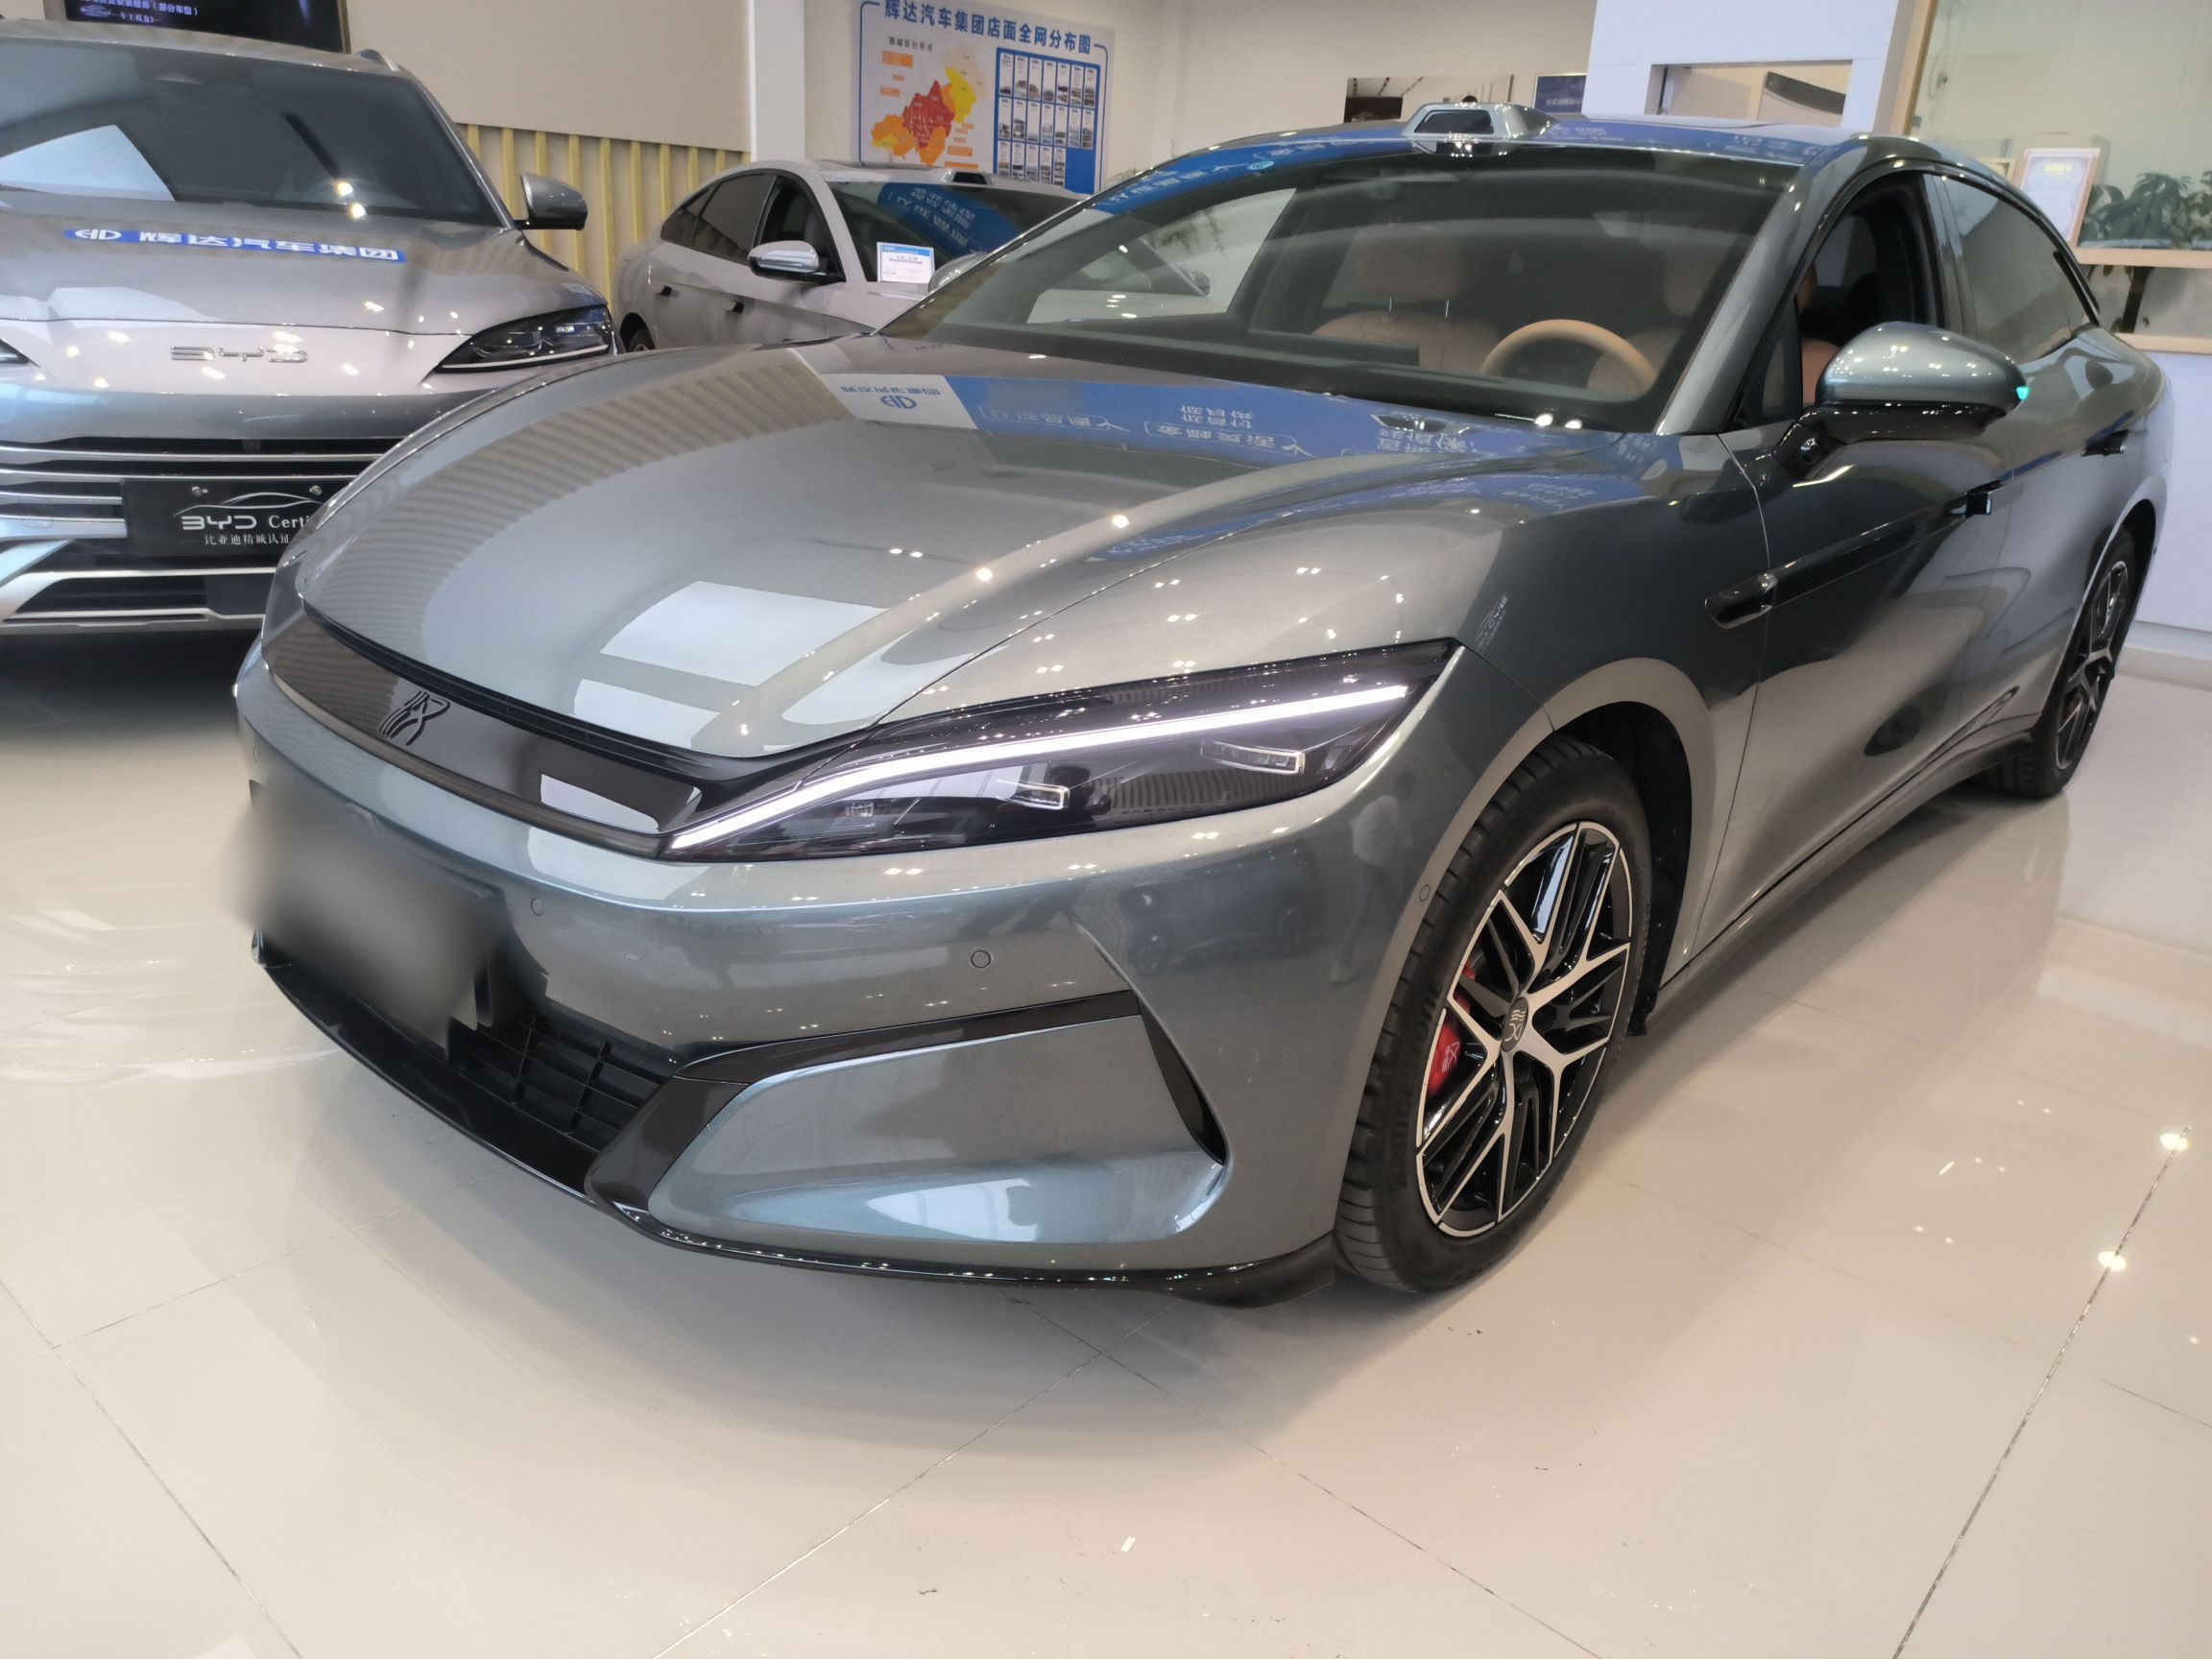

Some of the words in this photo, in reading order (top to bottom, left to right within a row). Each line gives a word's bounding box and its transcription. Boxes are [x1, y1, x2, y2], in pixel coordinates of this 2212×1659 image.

[884, 0, 1092, 55] 辉达汽车集团店面全网分布图
[139, 231, 398, 260] 辉达汽车集团
[170, 346, 308, 363] BYD
[181, 516, 257, 530] BYD
